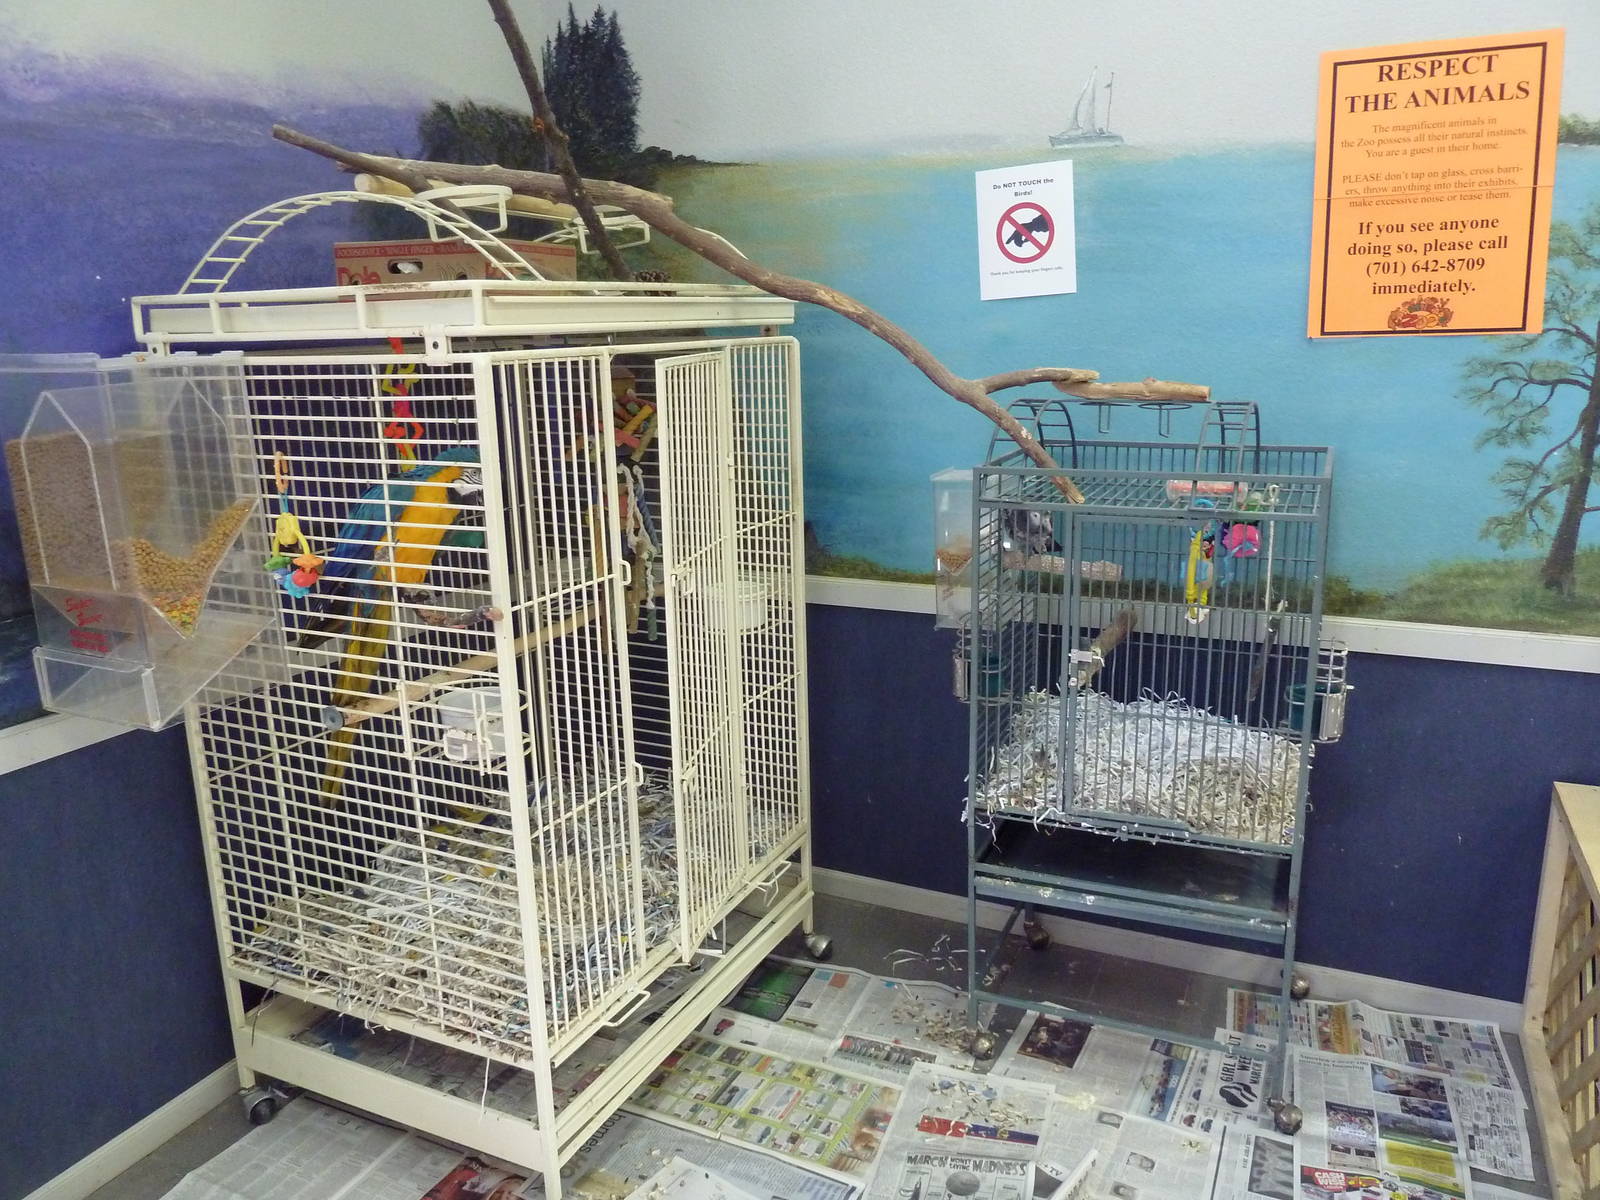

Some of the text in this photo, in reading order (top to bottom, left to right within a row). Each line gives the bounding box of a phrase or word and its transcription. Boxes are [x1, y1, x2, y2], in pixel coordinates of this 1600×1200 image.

[1377, 53, 1500, 83] RESPECT
[1345, 80, 1530, 114] THE ANIMALS
[1373, 115, 1497, 134] The magnificent animals in
[1341, 138, 1356, 148] the
[1357, 137, 1375, 147] Zoo
[1377, 136, 1411, 148] possess
[1413, 133, 1426, 143] all
[1428, 132, 1449, 142] their
[1451, 129, 1484, 140] natural
[1365, 149, 1383, 158] You
[1385, 149, 1400, 157] are
[1409, 146, 1434, 158] guest
[1437, 145, 1446, 153] in
[1448, 142, 1470, 153] their
[1002, 181, 1017, 189] NOT
[1018, 178, 1042, 187] TOUCH
[1342, 172, 1382, 184] PLEASE
[1410, 171, 1425, 183] tap
[1441, 167, 1468, 180] glass,
[1470, 167, 1494, 176] cross
[1497, 164, 1523, 174] barri-
[1363, 185, 1388, 194] throw
[1391, 182, 1431, 194] anything
[1433, 181, 1452, 190] into
[1454, 179, 1477, 189] their
[1349, 198, 1373, 208] make
[1375, 196, 1419, 206] excessive
[1420, 194, 1445, 204] noise
[1447, 194, 1458, 202] or
[1459, 193, 1483, 201] tease
[1358, 217, 1500, 238] If you see anyone
[1347, 235, 1508, 257] doing so, please call
[1366, 257, 1486, 278] (701) 642-8709
[1371, 278, 1476, 296] immediately.
[1220, 1034, 1241, 1082] GIRL SUT
[1237, 1055, 1252, 1071] WEE
[906, 1154, 949, 1168] MARCH
[972, 1159, 1027, 1177] MADNESS
